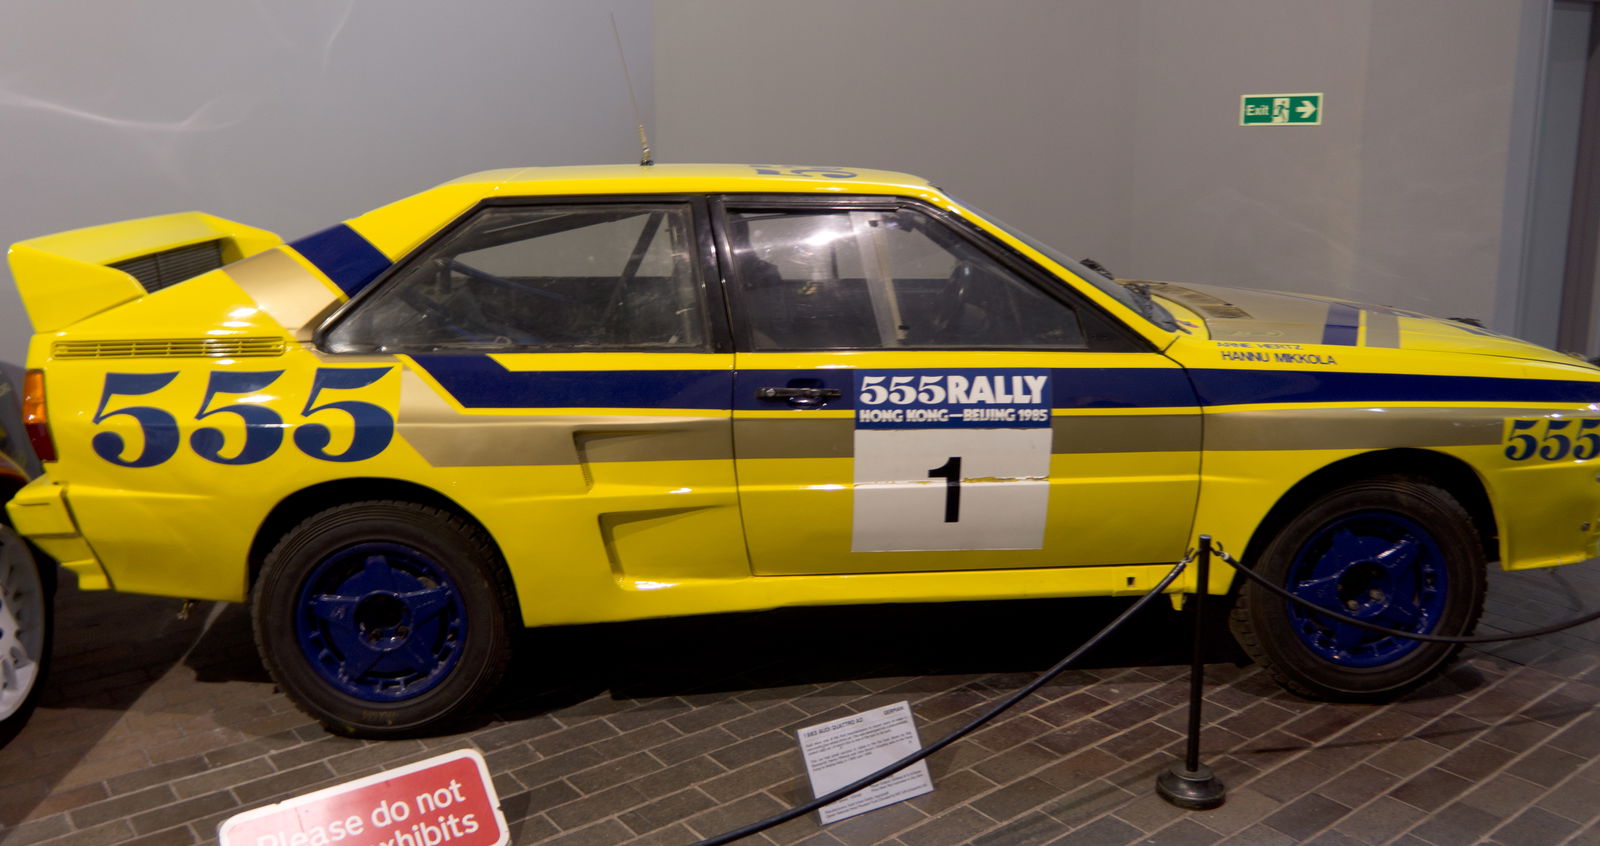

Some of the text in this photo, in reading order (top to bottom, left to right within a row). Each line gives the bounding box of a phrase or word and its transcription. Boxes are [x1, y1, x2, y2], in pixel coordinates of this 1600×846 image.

[1246, 104, 1269, 116] Exit
[1220, 351, 1338, 366] HANNU MIKKOLA
[91, 366, 395, 469] 555
[858, 409, 903, 423] HONG
[1018, 408, 1048, 422] 1985
[1504, 419, 1600, 462] 555
[927, 456, 962, 524] 1
[370, 799, 411, 828] do
[415, 779, 467, 815] not
[372, 812, 480, 846] hibits
